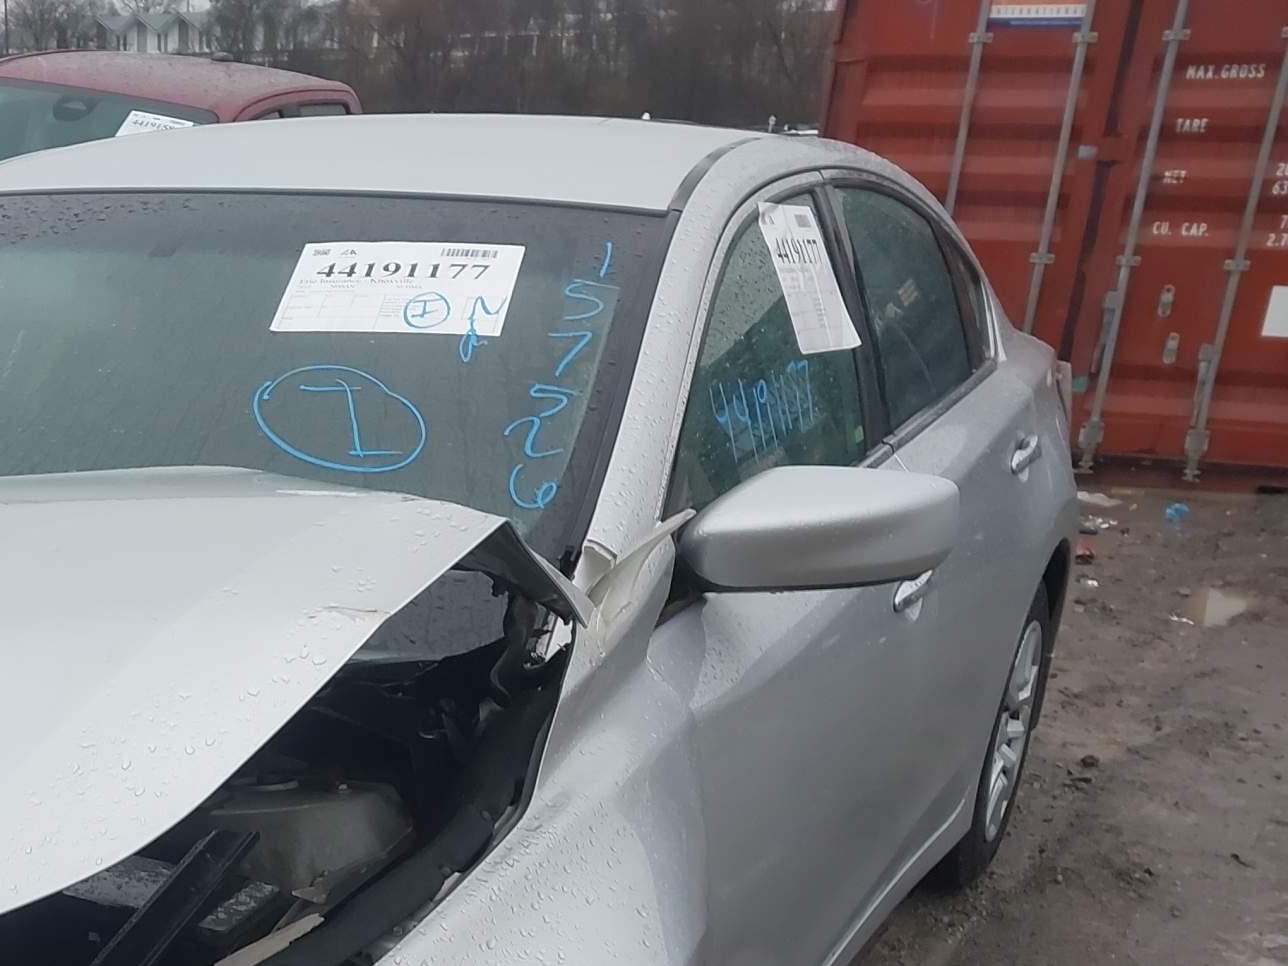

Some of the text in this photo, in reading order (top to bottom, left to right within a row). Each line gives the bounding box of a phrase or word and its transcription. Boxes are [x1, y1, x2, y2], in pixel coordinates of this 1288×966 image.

[1186, 64, 1266, 80] MAX.GROSS
[1176, 118, 1209, 133] TARE
[1152, 222, 1209, 237] CU. CAP.
[775, 238, 822, 264] 44191177
[316, 262, 491, 279] 44191177
